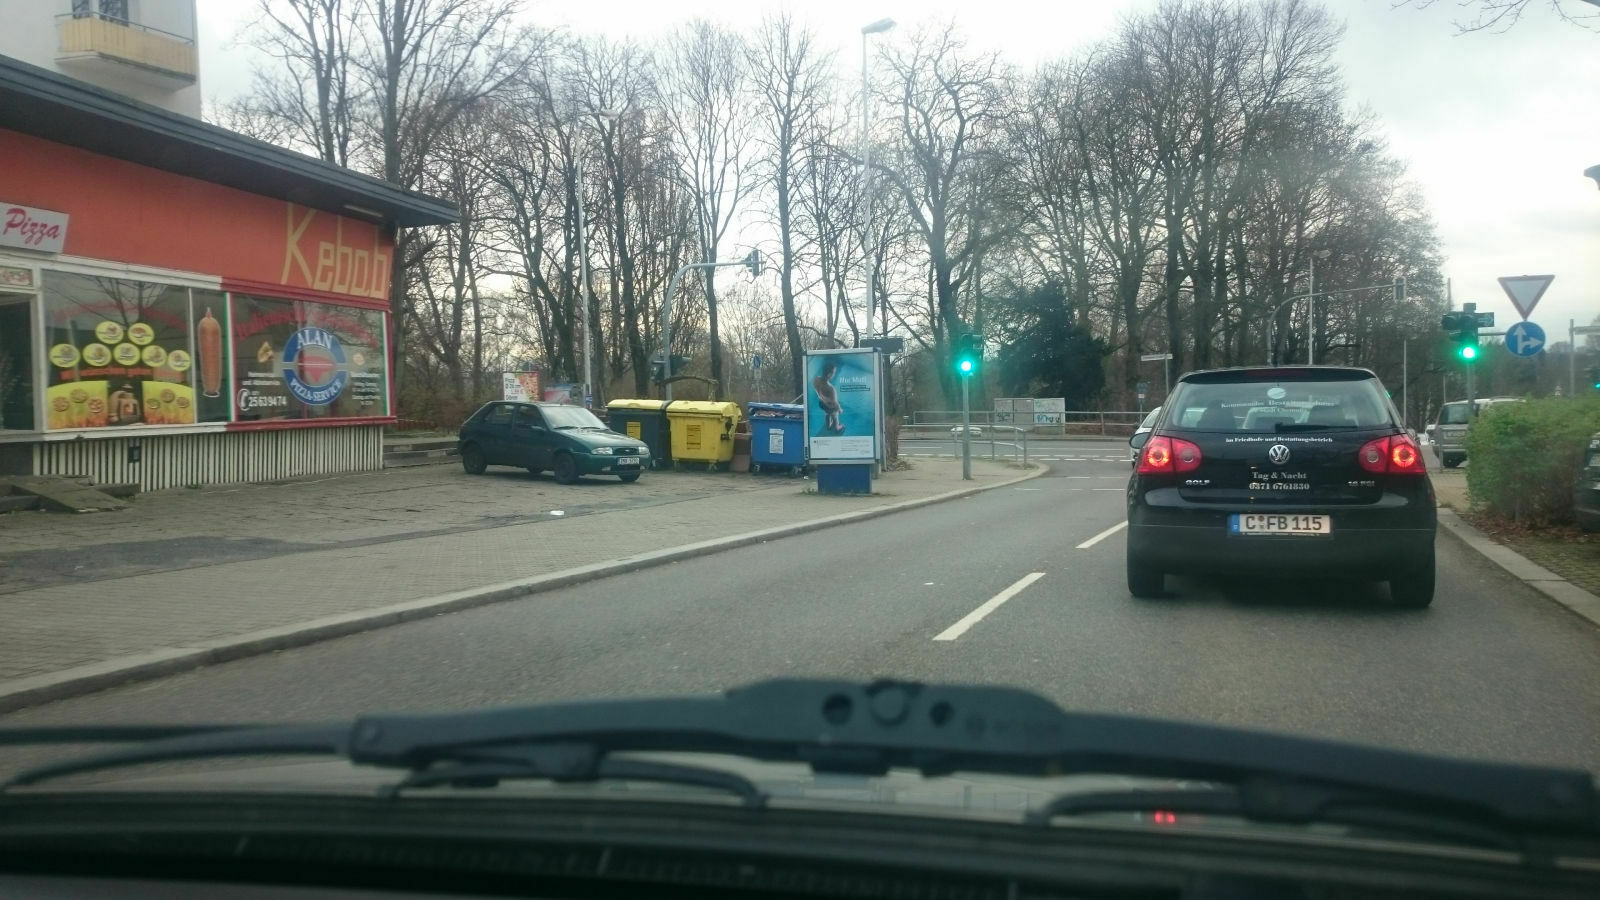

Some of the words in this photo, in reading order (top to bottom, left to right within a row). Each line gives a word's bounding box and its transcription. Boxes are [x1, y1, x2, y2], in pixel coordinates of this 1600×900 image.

[3, 208, 60, 245] Pizza
[281, 203, 387, 299] Kebab
[297, 329, 333, 350] ALAN
[290, 377, 342, 402] PIZZA-SERVICE
[249, 396, 287, 407] 25639474
[1252, 472, 1269, 480] Tag
[1249, 482, 1270, 490] 0371
[1291, 517, 1322, 531] 115
